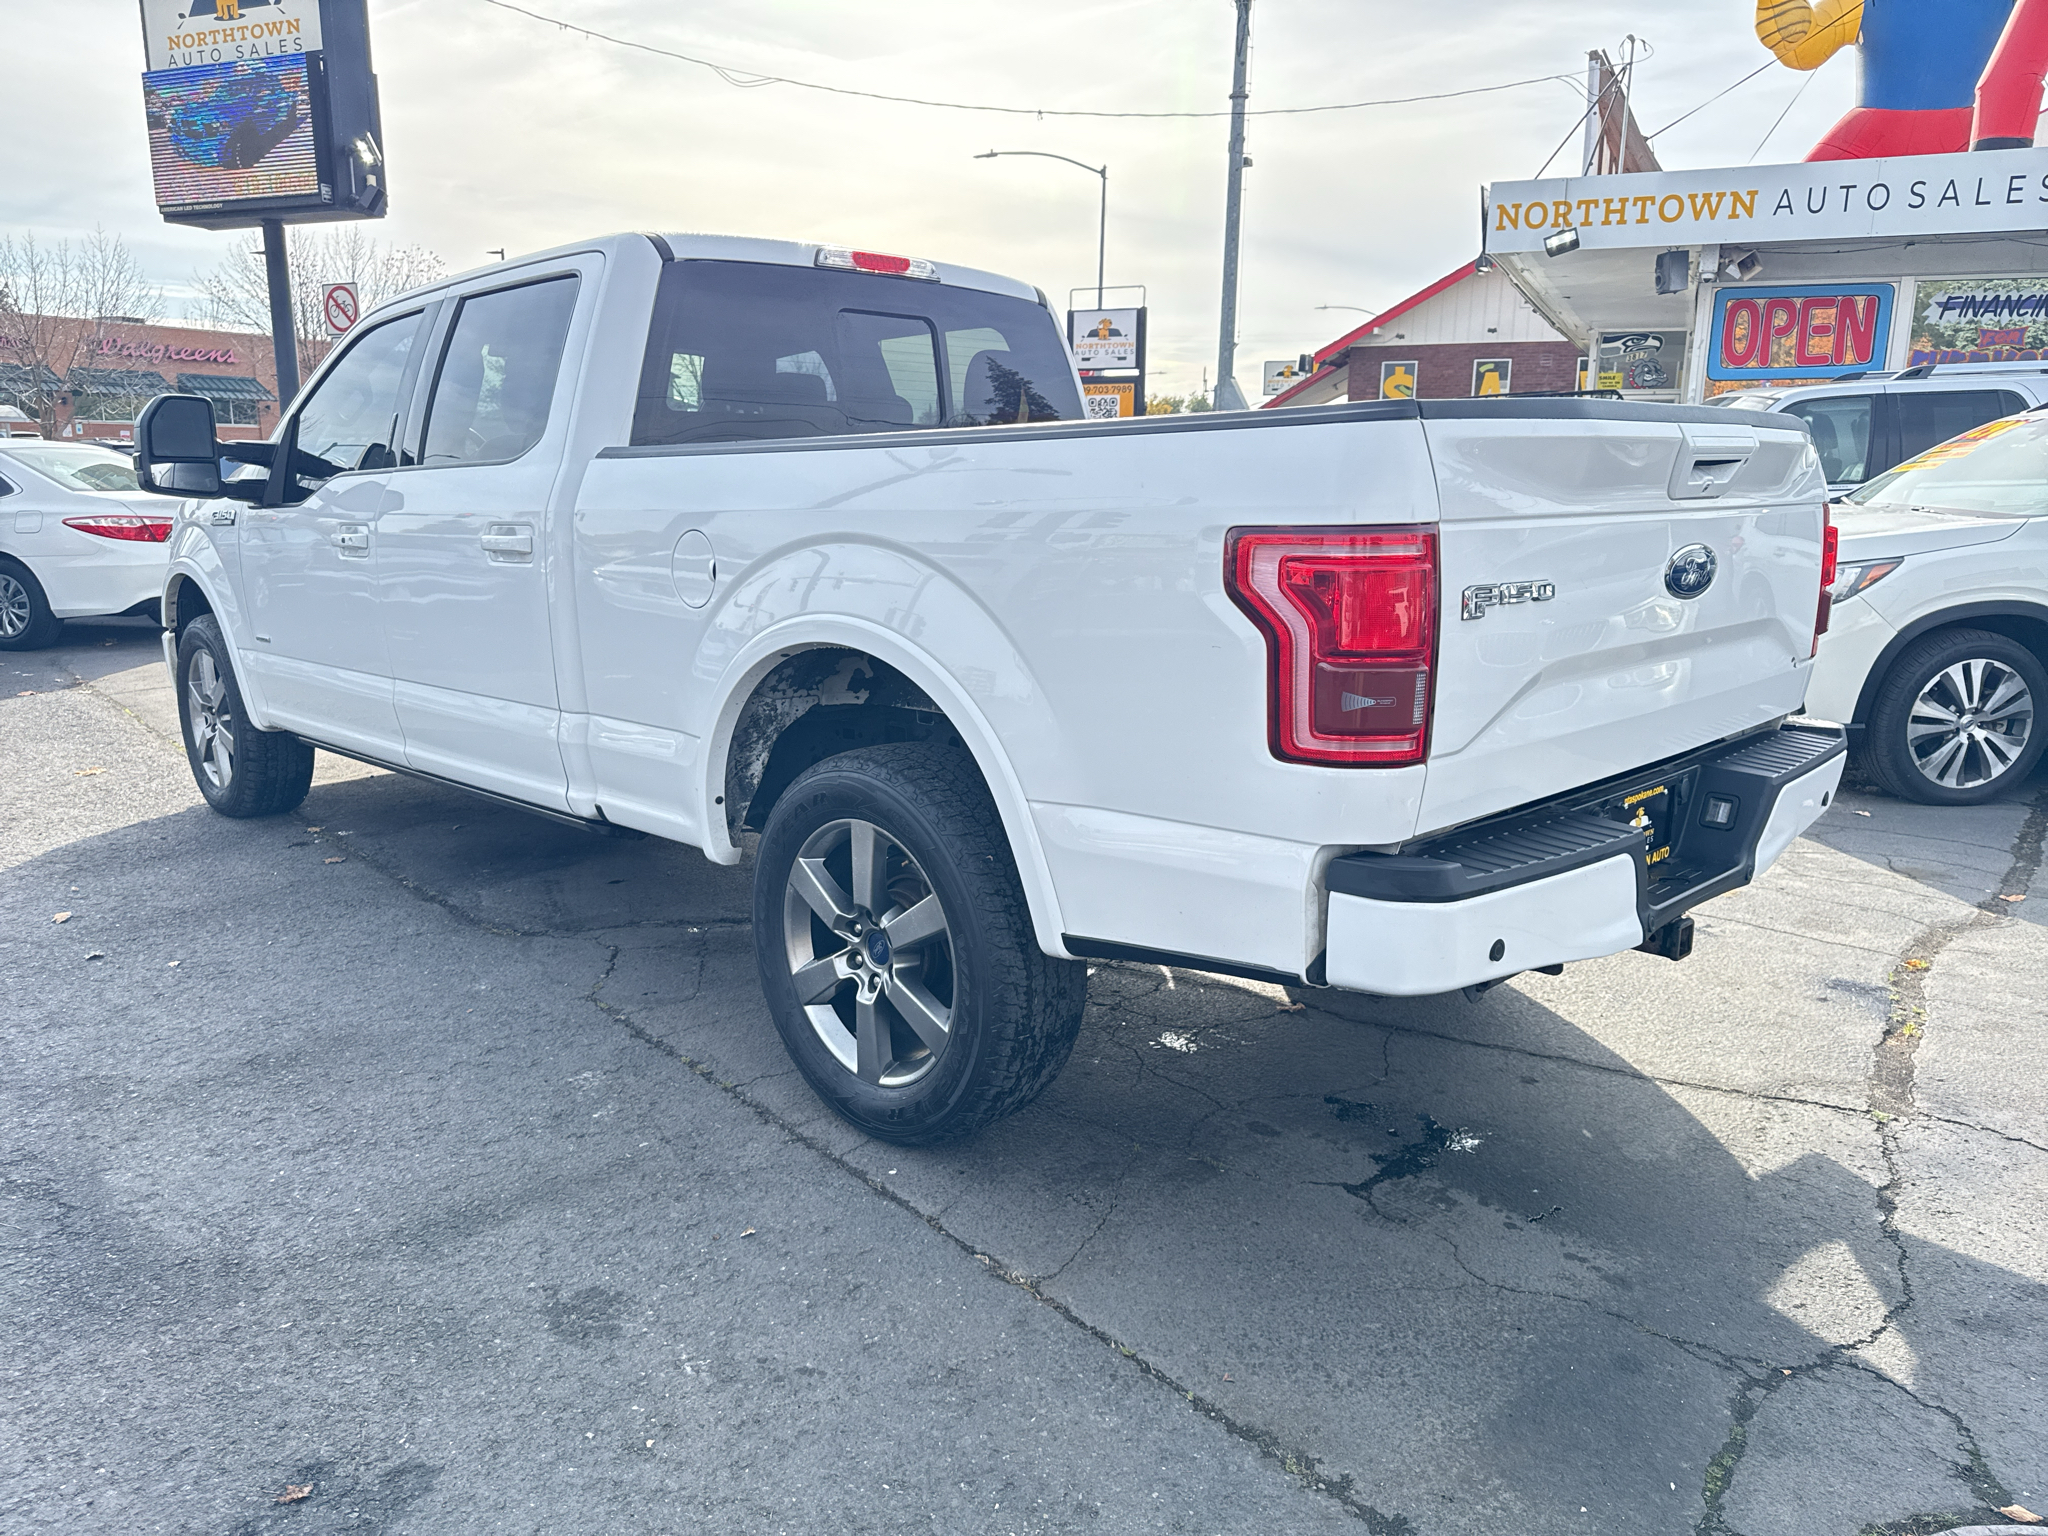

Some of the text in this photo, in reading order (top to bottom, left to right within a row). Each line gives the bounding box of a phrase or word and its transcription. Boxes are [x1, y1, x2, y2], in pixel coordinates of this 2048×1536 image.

[168, 18, 301, 50] NORTHTOWN
[168, 37, 303, 67] AUTO SALES
[1496, 190, 1759, 231] NORTHTOWN
[1773, 182, 1891, 217] AUTO
[1722, 295, 1879, 367] OPEN
[1982, 331, 2021, 346] FOR
[97, 338, 240, 364] Walgreens
[1624, 785, 1665, 804] ntaspokane.com
[1652, 846, 1670, 864] AUTO
